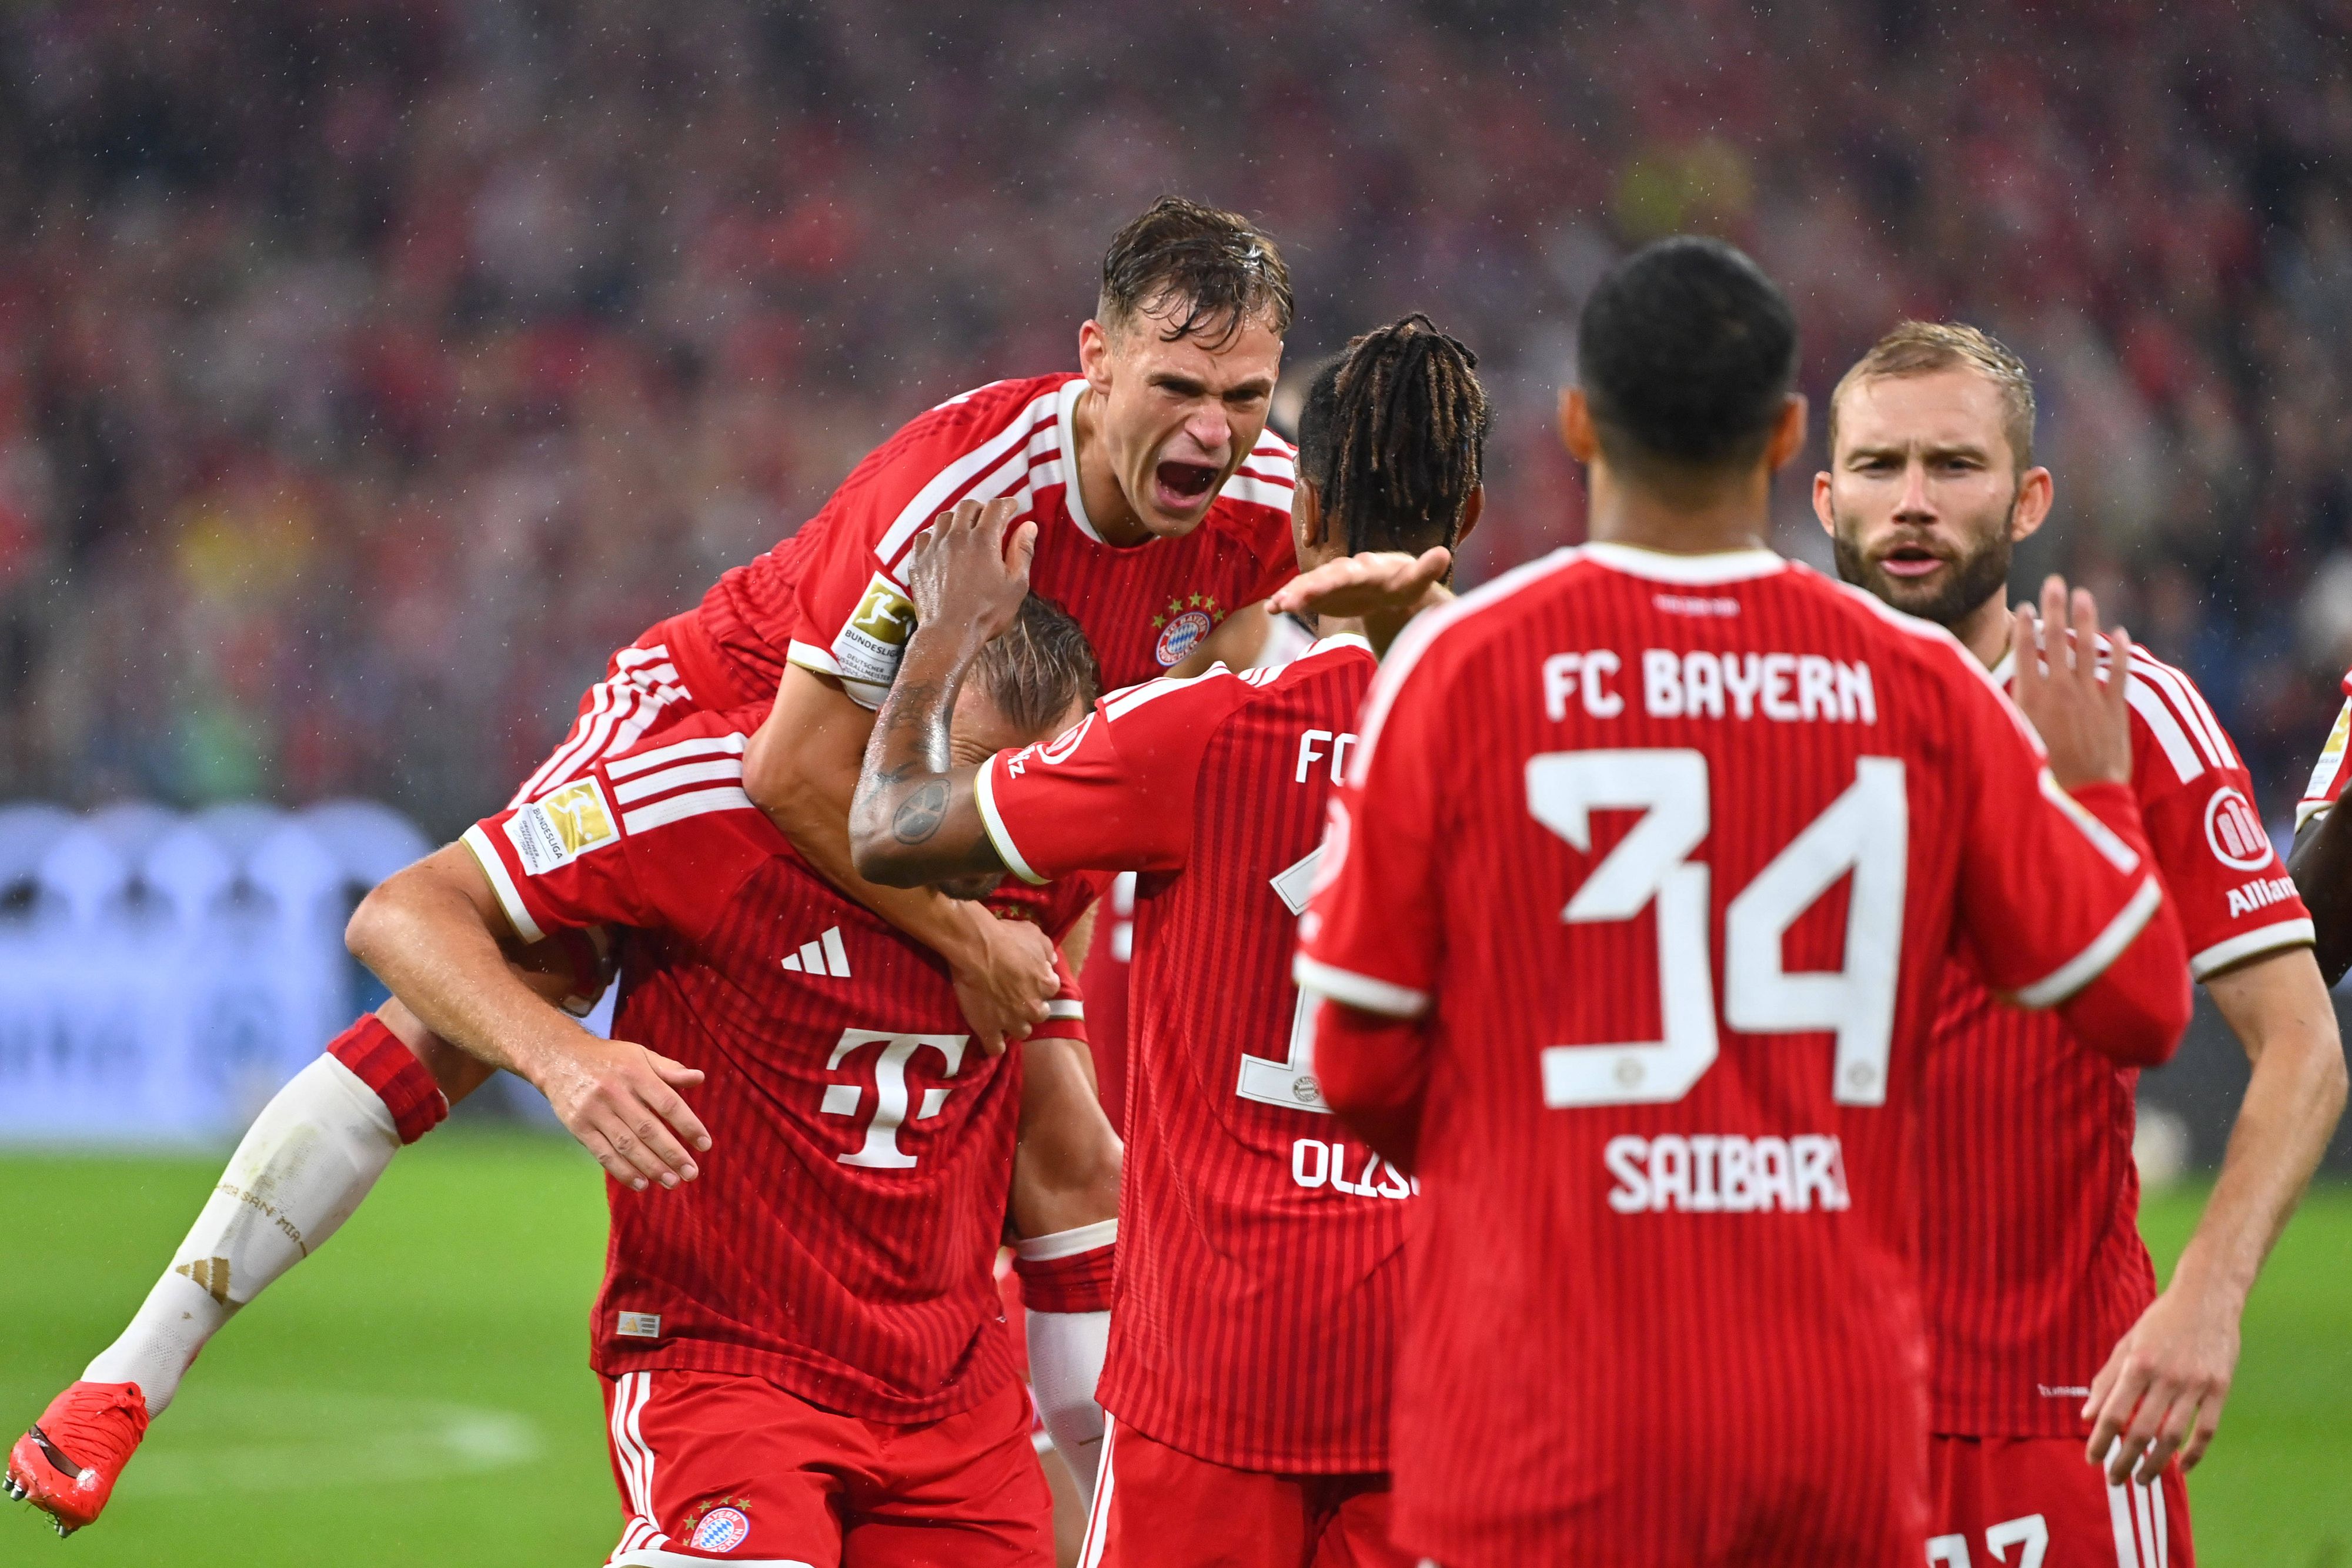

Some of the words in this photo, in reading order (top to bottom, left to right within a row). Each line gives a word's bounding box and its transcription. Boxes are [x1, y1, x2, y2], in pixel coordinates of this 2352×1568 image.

[845, 629, 901, 658] BUNDESLIG
[847, 653, 884, 673] DEUTSCHER
[1543, 648, 1625, 722] FC
[1643, 647, 1878, 726] BAYERN
[1295, 728, 1359, 787] FC
[522, 820, 540, 857] DEUTSCHER
[532, 807, 563, 860] BUNDESLIGA
[2225, 875, 2301, 920] Allian
[1525, 747, 1910, 1110] 34
[820, 1027, 971, 1169] T
[1292, 1138, 1421, 1200] OLIS
[275, 1215, 300, 1243] MIA
[699, 1510, 741, 1529] BAYERN
